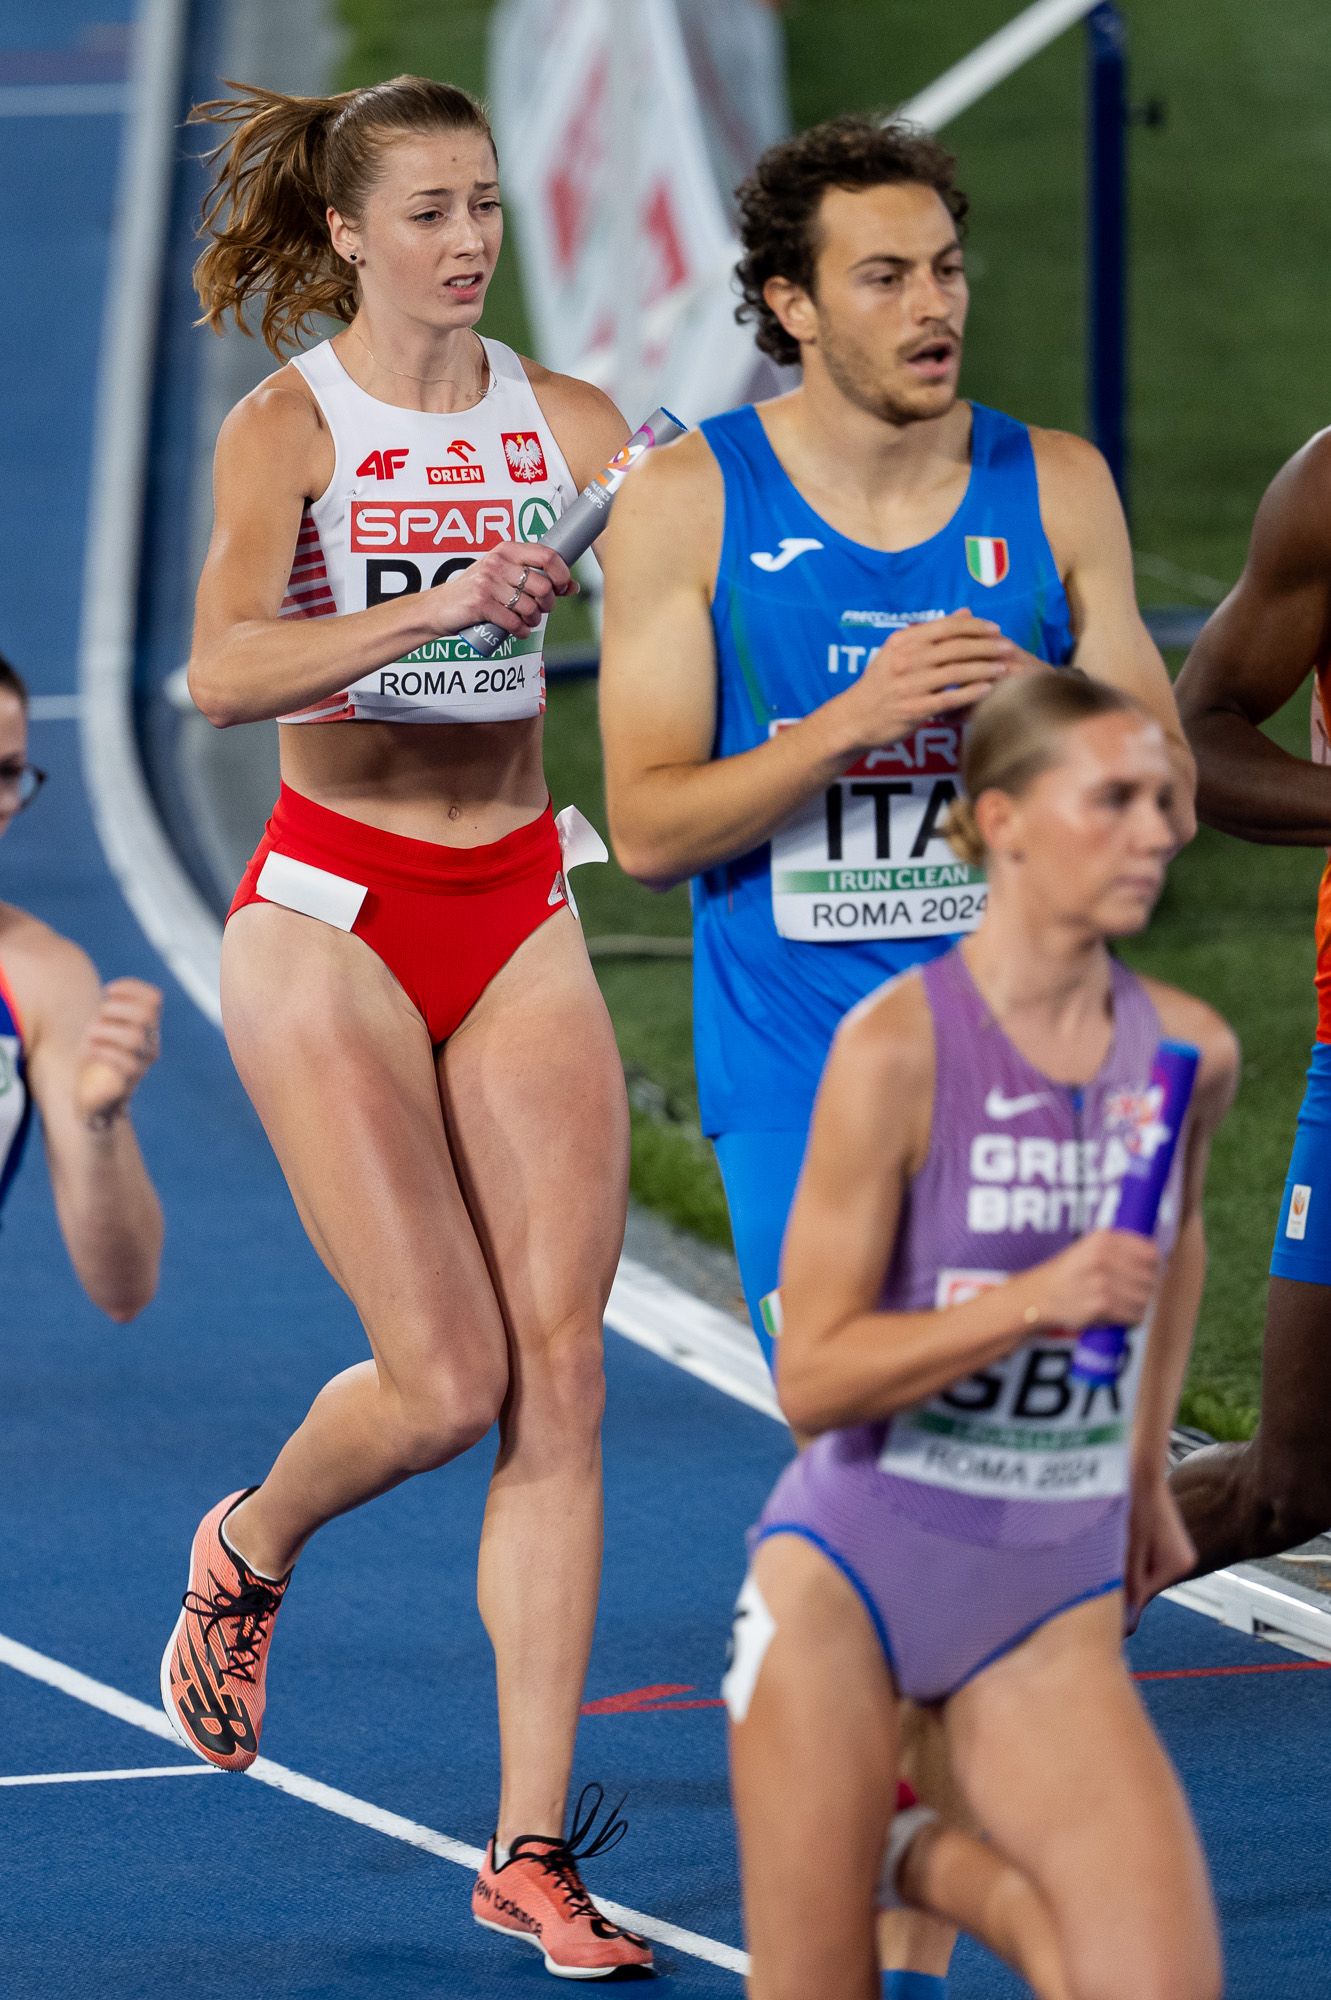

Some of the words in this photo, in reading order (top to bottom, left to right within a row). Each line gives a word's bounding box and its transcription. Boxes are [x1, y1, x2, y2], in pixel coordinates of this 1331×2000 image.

[356, 449, 409, 480] 4F
[430, 468, 482, 483] ORLEN
[356, 507, 512, 546] SPAR
[380, 671, 467, 696] ROMA
[474, 664, 526, 694] 2024
[828, 872, 836, 891] I
[841, 871, 892, 891] RUN
[896, 866, 970, 889] CLEAN
[813, 901, 912, 927] ROMA
